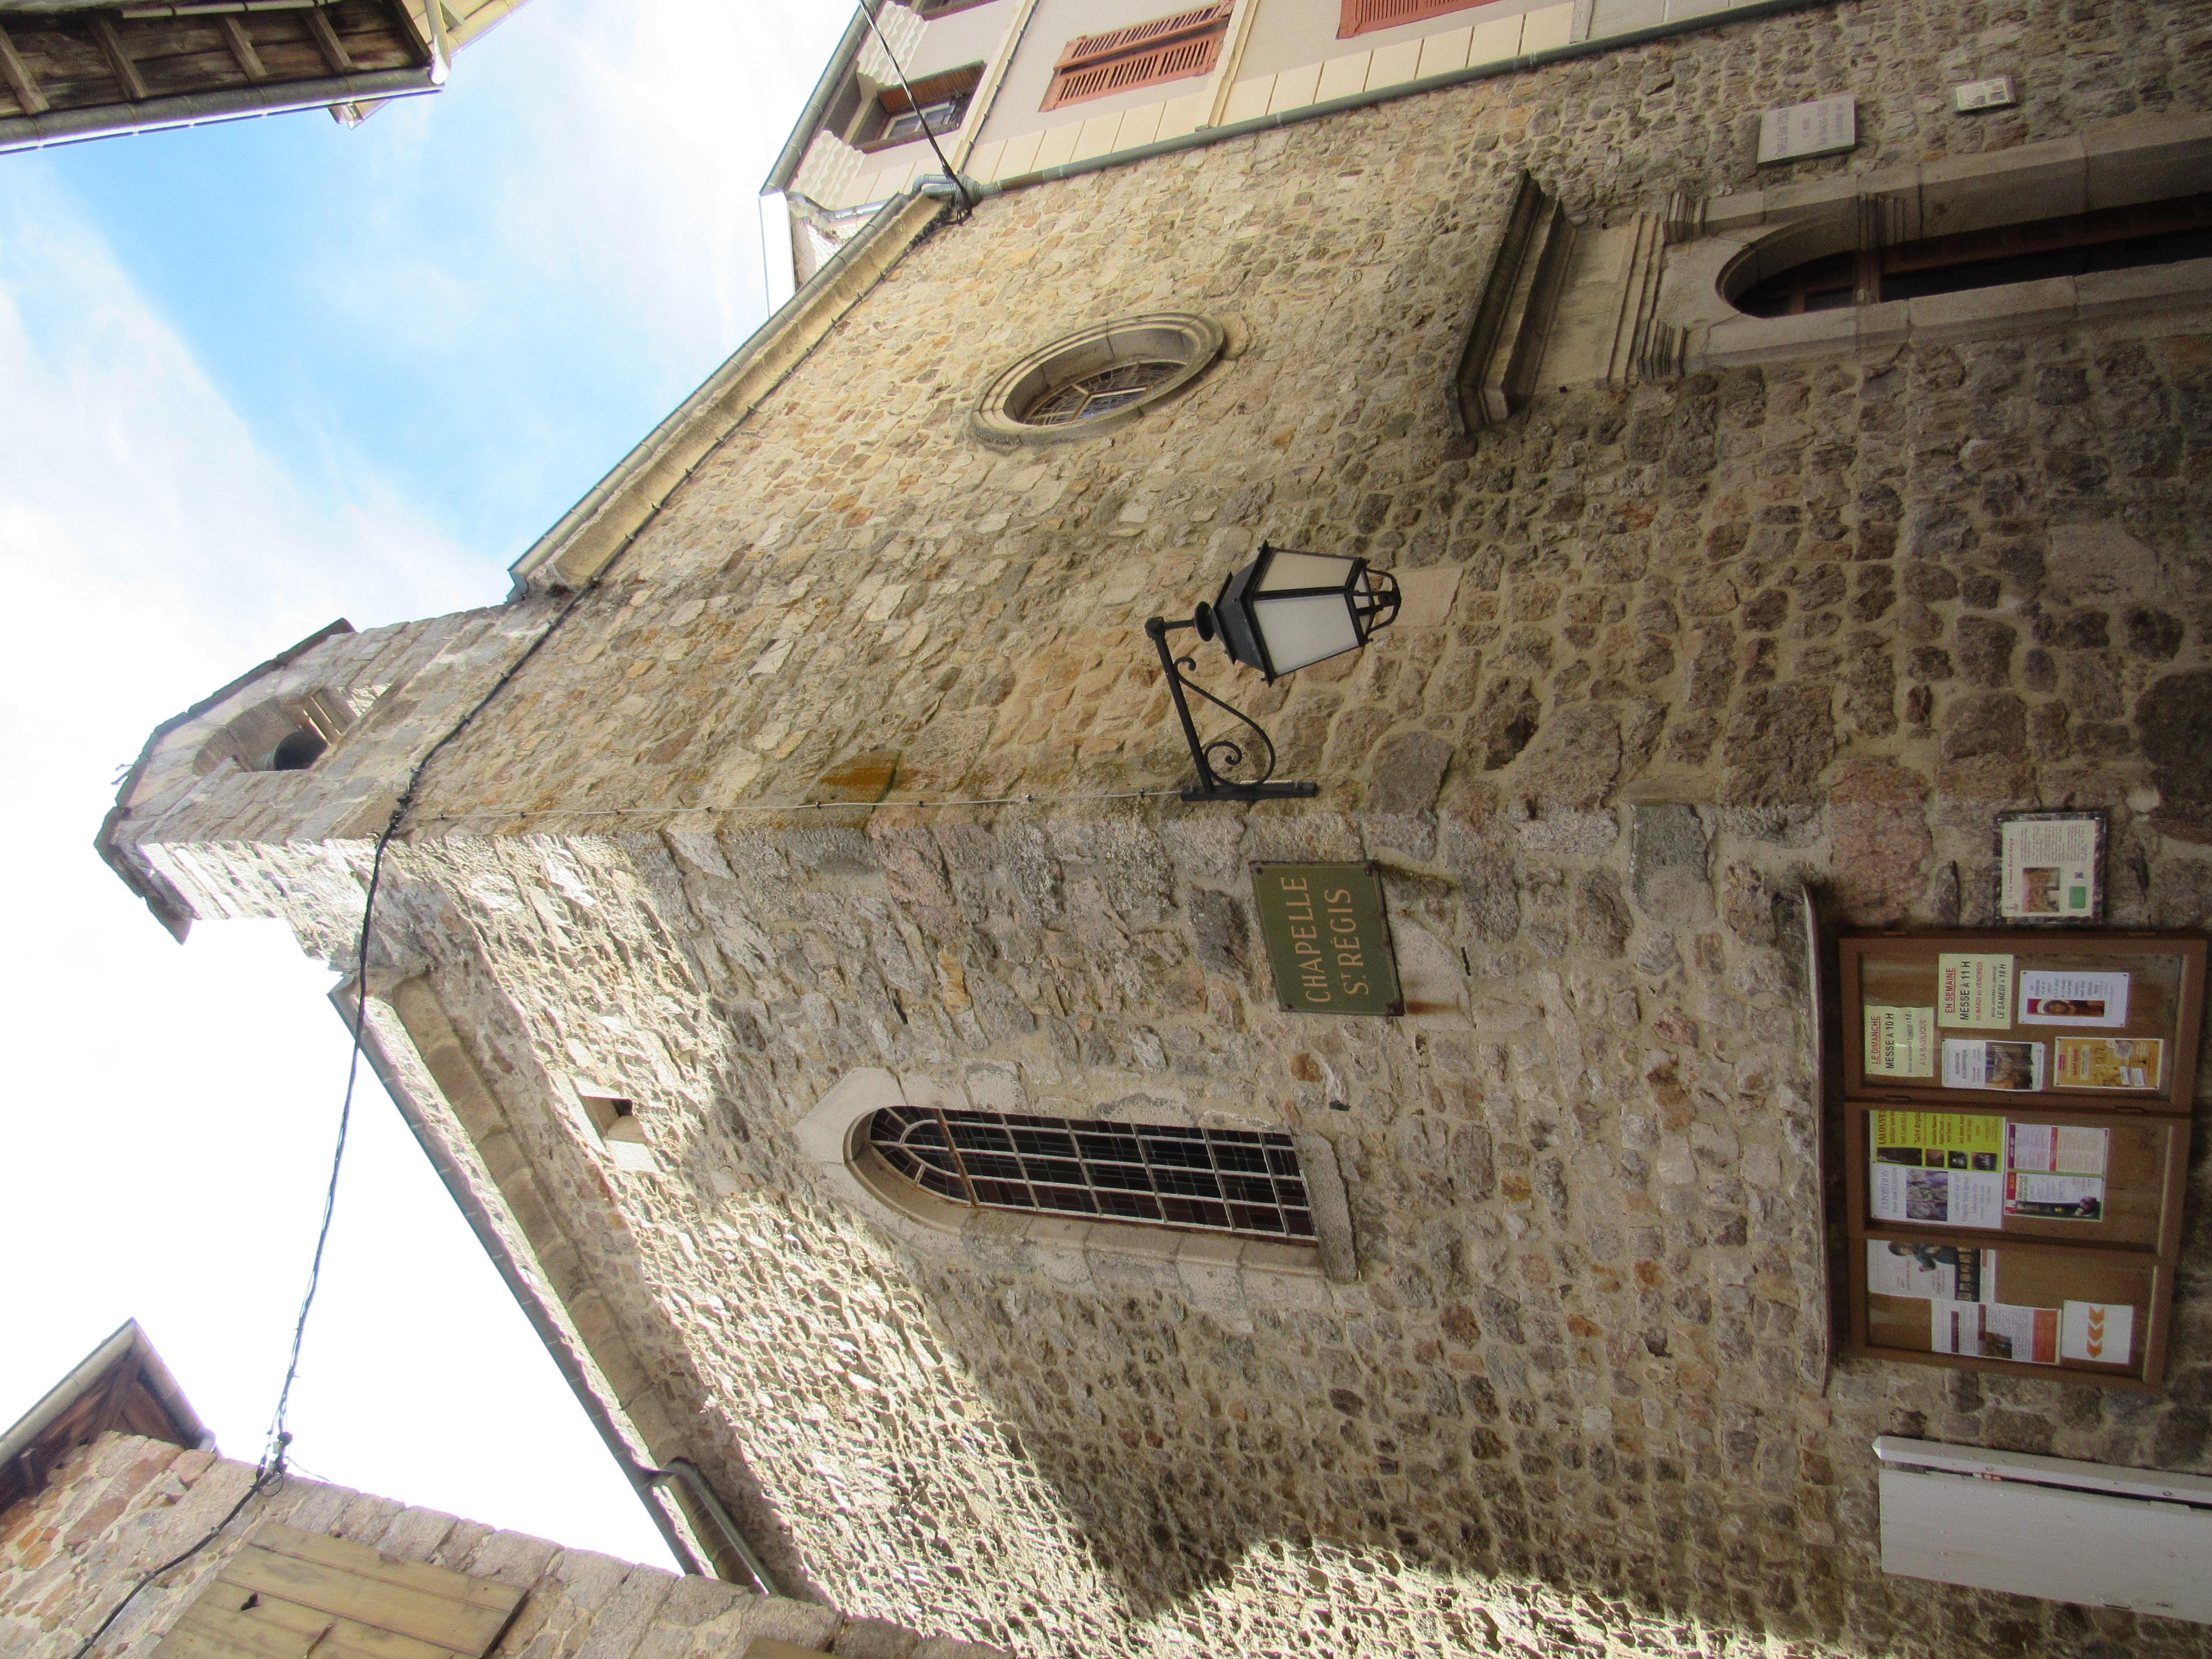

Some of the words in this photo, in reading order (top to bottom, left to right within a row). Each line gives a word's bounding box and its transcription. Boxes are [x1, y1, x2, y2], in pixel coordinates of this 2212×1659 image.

[1281, 877, 1331, 1003] CHAPELLE
[1324, 889, 1364, 966] RÉGIS
[1945, 968, 1954, 1001] SEMAINE
[1960, 971, 1971, 980] 11
[1945, 1003, 1953, 1013] EN
[1960, 990, 1970, 1020] MESSE
[1997, 984, 2005, 1010] SAMEDI
[1885, 1021, 1894, 1030] 10
[1997, 1011, 2005, 1019] LE
[1870, 1016, 1879, 1054] DIMANCHE
[1871, 1055, 1879, 1065] LE
[1885, 1040, 1894, 1069] MESSE
